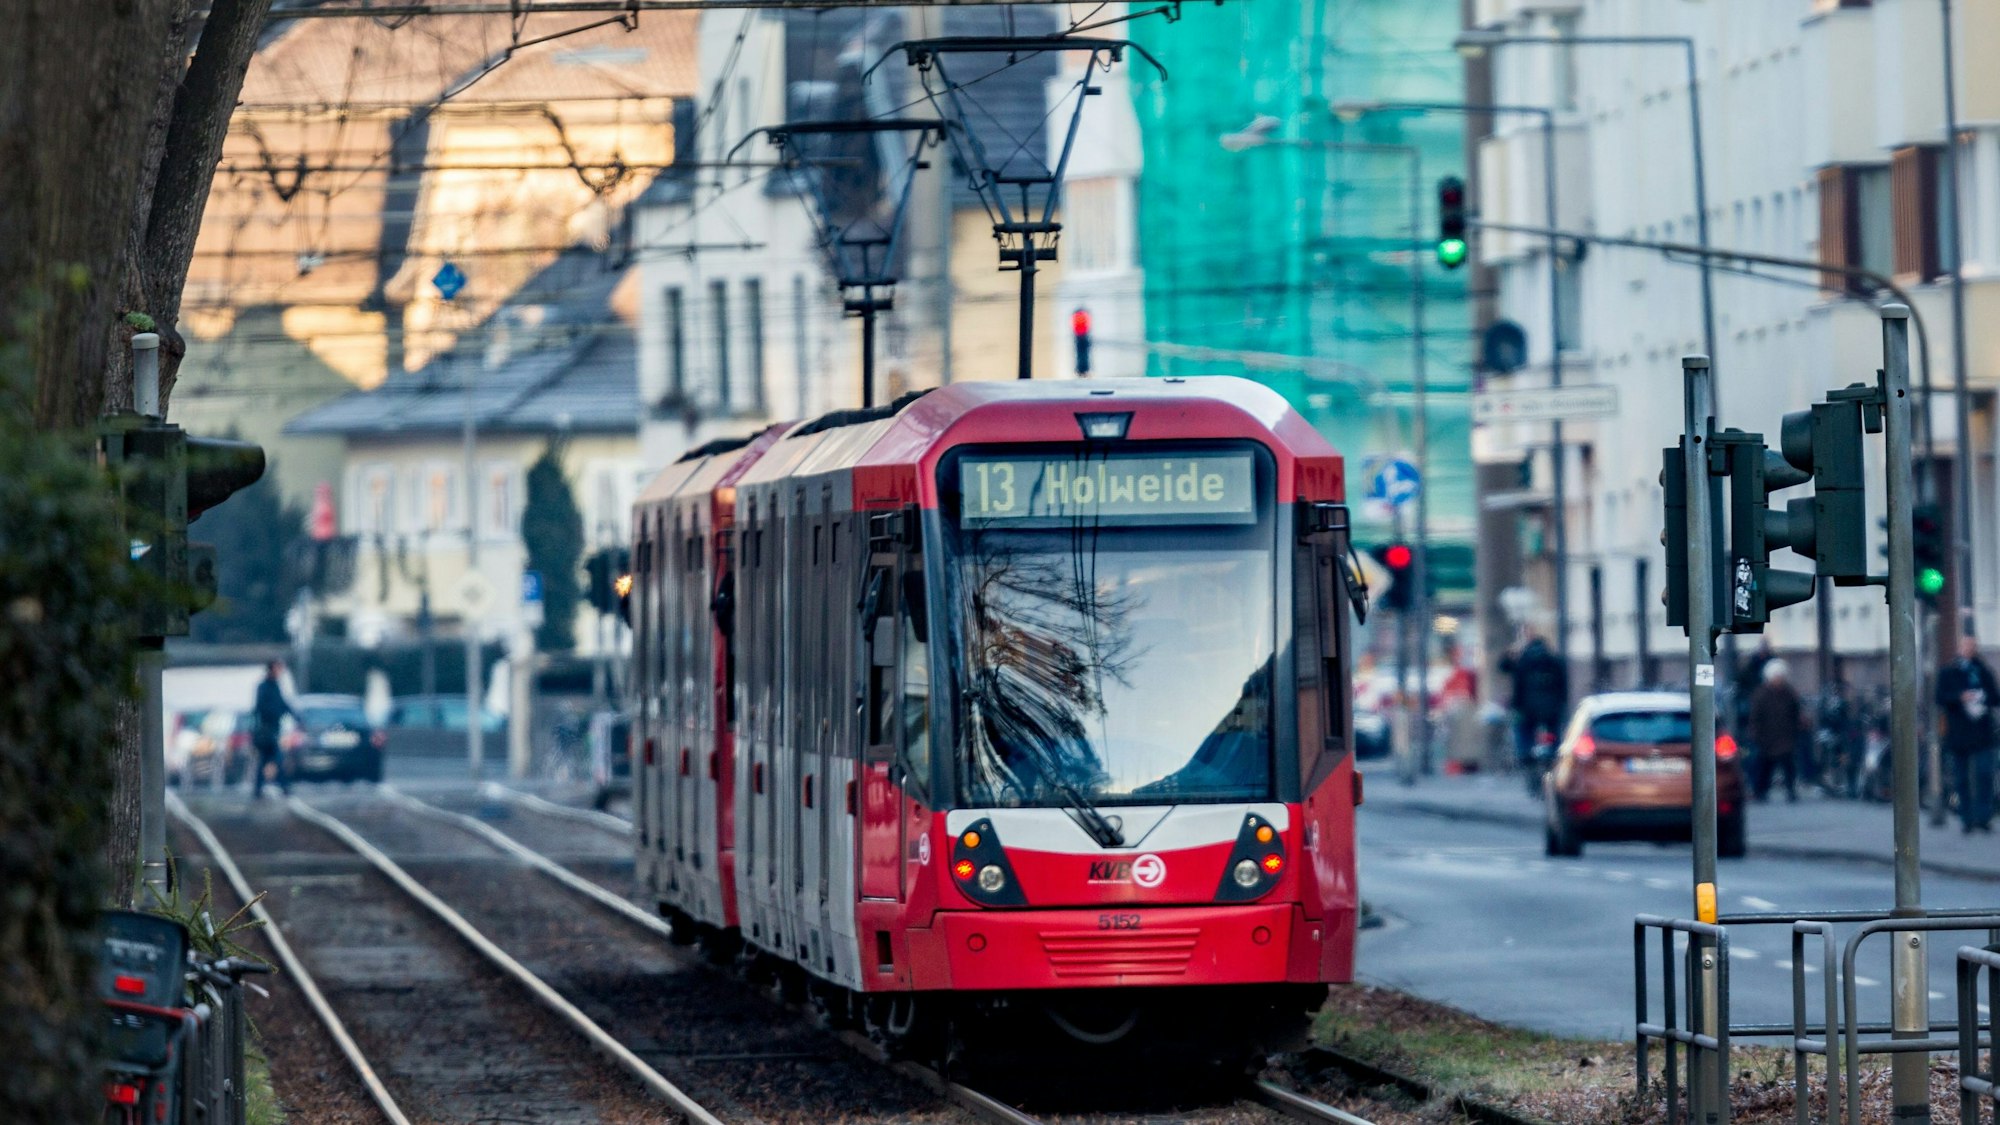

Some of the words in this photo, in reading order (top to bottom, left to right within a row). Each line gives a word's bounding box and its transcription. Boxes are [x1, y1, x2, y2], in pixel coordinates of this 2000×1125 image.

[976, 463, 1015, 512] 13
[1046, 462, 1225, 504] Holweide
[1089, 861, 1132, 880] KVB
[1098, 914, 1141, 930] 5152
